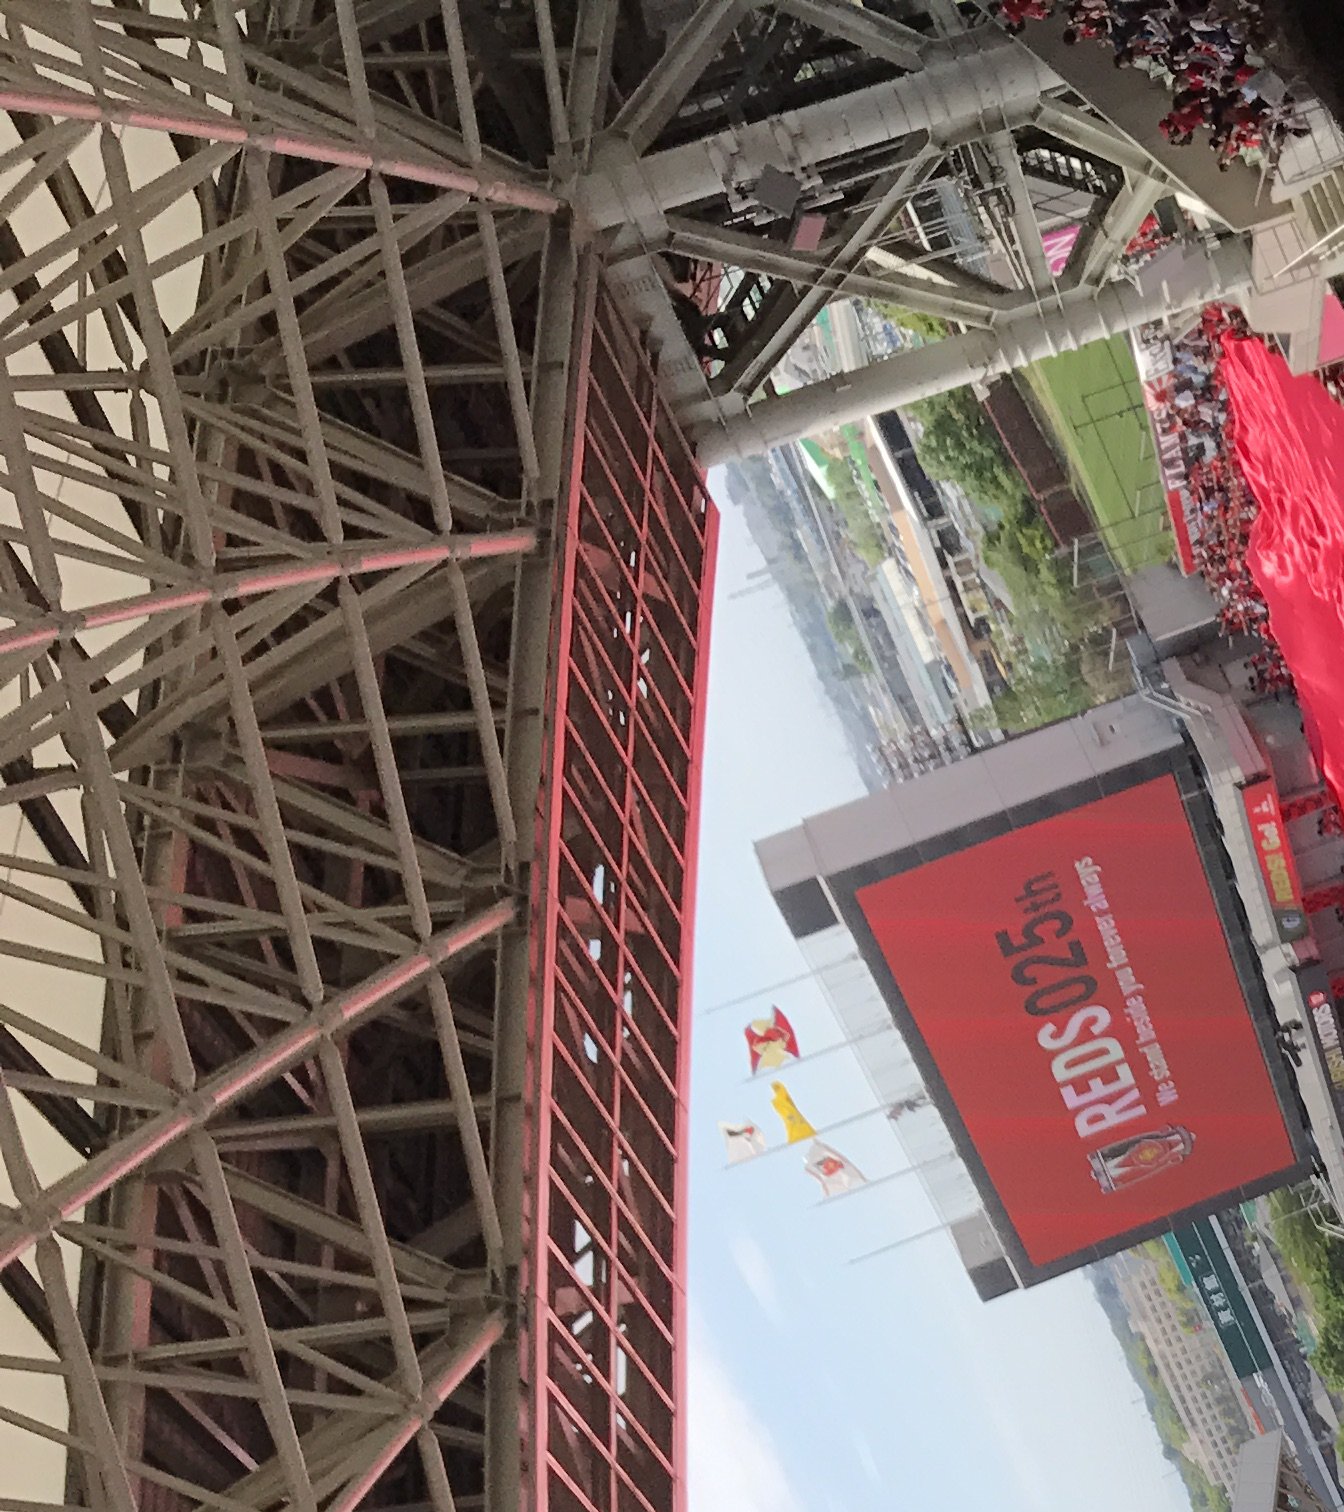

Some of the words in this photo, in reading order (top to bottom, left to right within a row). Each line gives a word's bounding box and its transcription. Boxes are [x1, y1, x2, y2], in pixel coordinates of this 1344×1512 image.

[1074, 856, 1110, 915] always
[1264, 855, 1293, 902] REDS!
[1094, 914, 1129, 969] forever
[1114, 967, 1145, 996] you
[1123, 995, 1157, 1045] beside
[1312, 1004, 1342, 1048] MOTORS
[1138, 1043, 1170, 1081] stand
[1155, 1080, 1178, 1106] We
